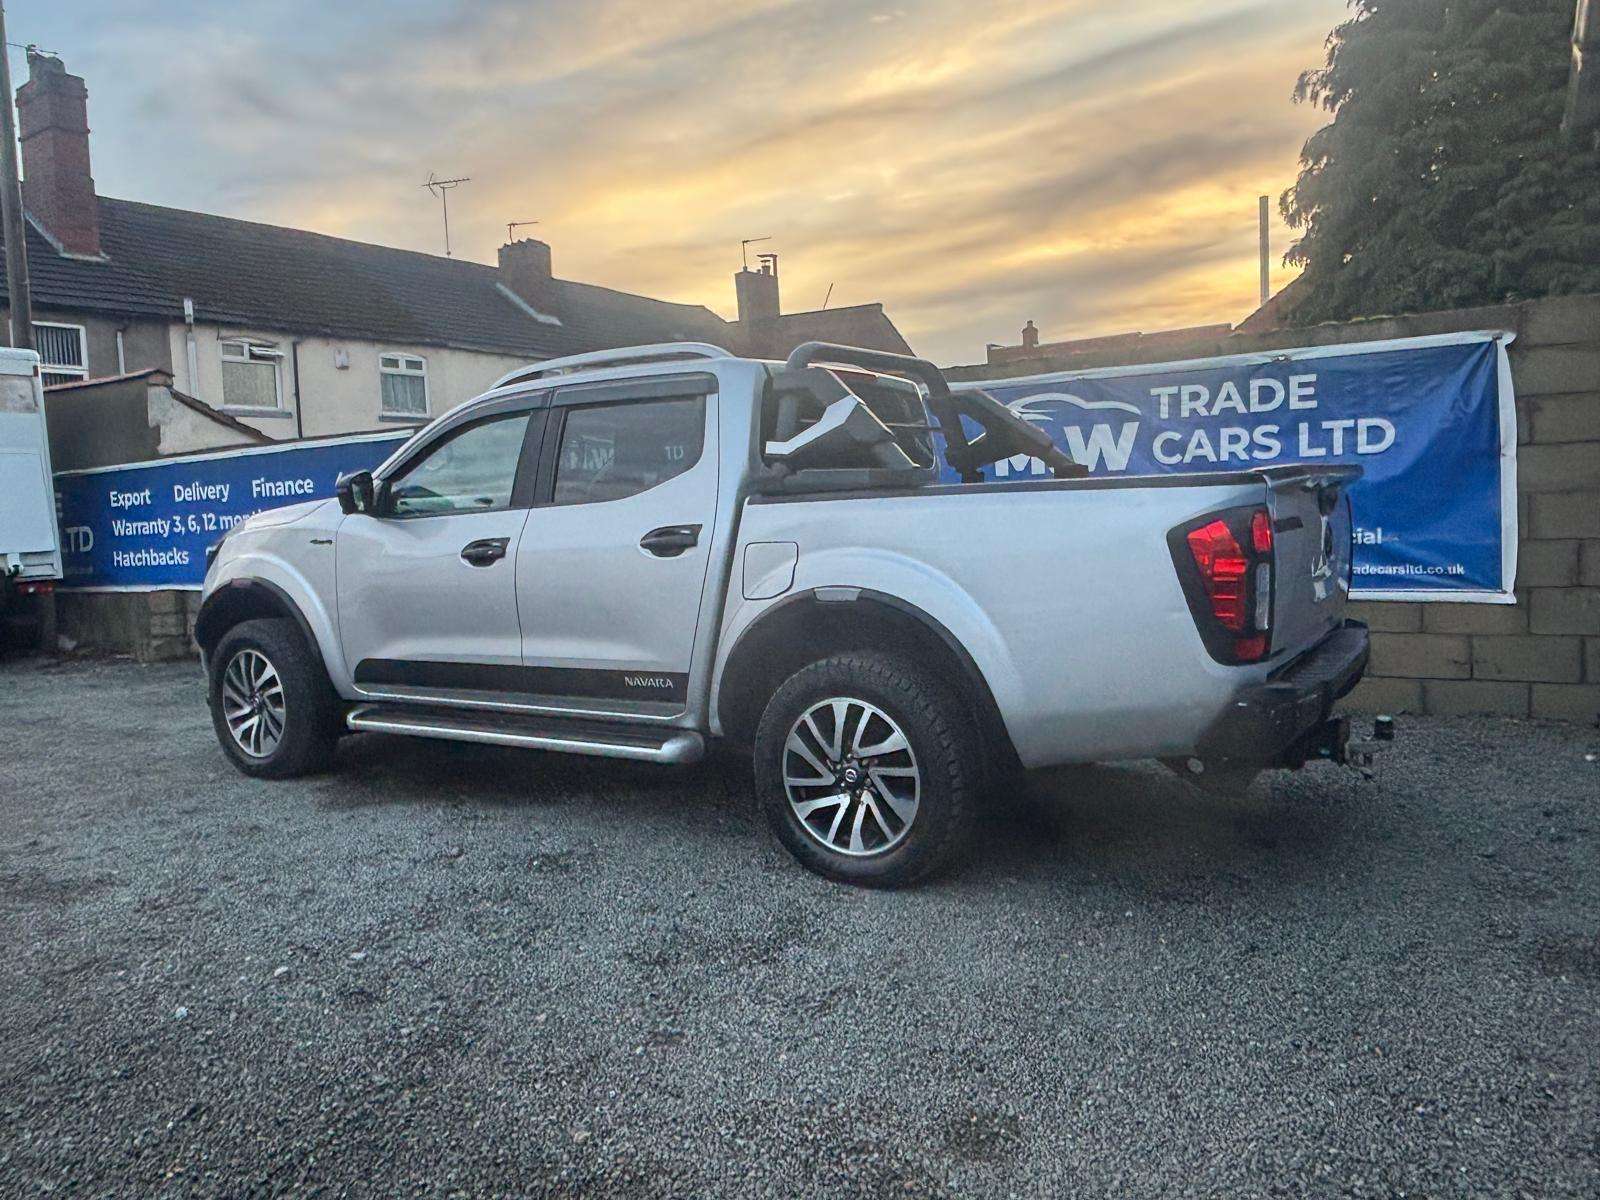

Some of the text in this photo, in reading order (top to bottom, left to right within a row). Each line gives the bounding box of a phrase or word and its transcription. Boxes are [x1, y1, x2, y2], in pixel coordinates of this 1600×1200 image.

[1151, 374, 1318, 419] TRADE
[1152, 418, 1396, 465] CARS LTD
[109, 478, 314, 510] Export Delivery Finance
[112, 517, 171, 538] Warranty
[172, 515, 185, 535] 3,
[187, 514, 200, 535] 6,
[201, 512, 217, 531] 12
[113, 547, 190, 567] Hatchbacks
[624, 676, 674, 689] NAVARA
